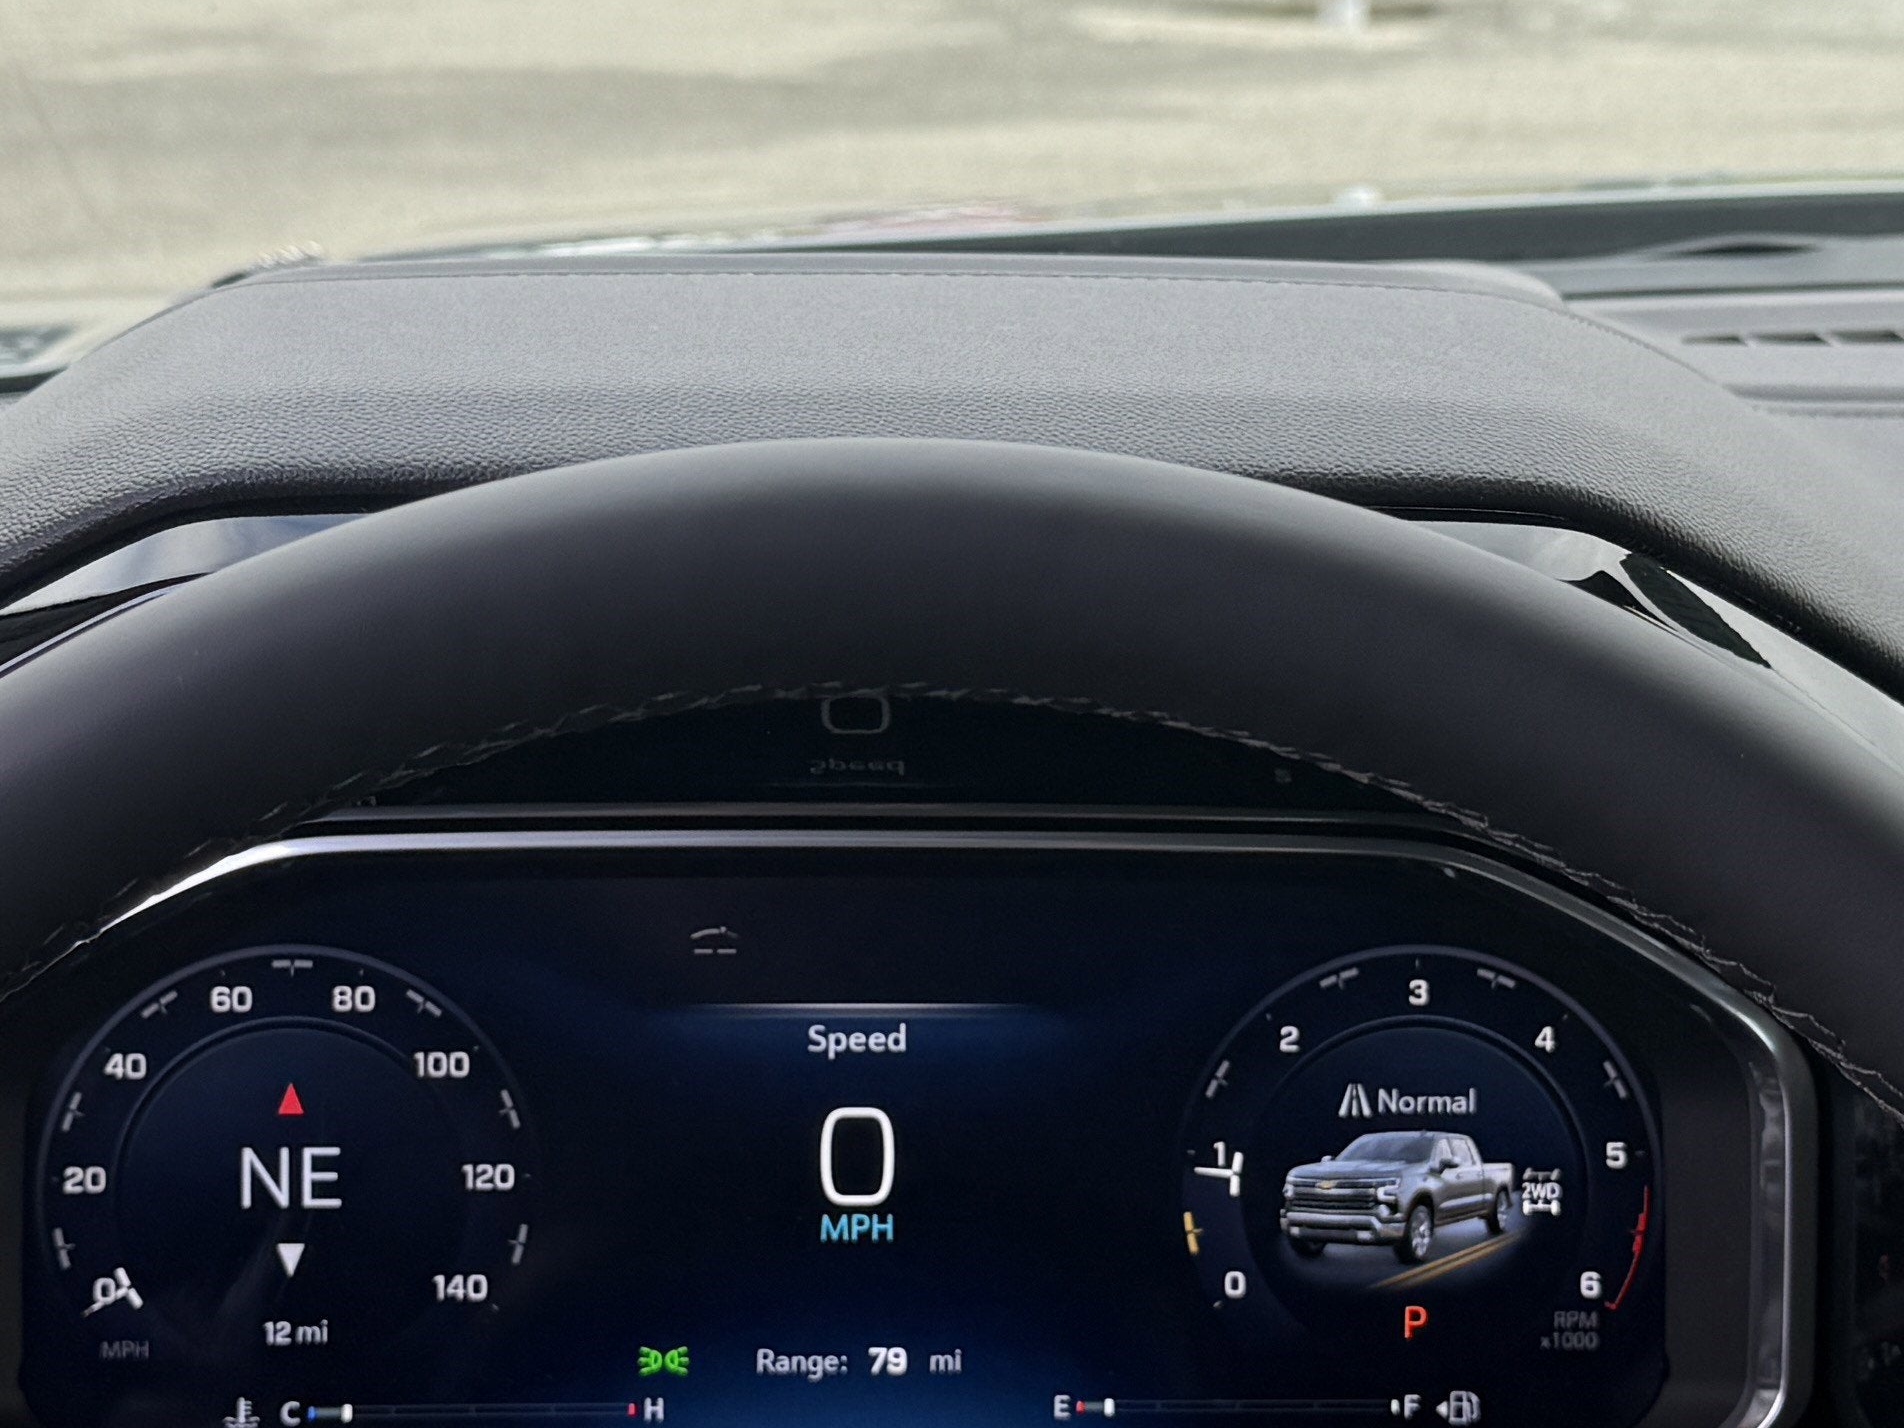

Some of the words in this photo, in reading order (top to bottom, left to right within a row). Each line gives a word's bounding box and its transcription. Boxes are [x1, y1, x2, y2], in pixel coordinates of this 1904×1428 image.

[210, 985, 253, 1013] 60
[331, 985, 376, 1013] 80
[1408, 979, 1430, 1006] 3
[807, 1022, 907, 1061] Speed
[1279, 1025, 1300, 1053] 2
[1534, 1025, 1558, 1052] 4
[104, 1052, 147, 1080] 40
[413, 1051, 470, 1079] 100
[1377, 1088, 1477, 1116] Normal
[819, 1106, 895, 1207] 0
[1212, 1141, 1227, 1167] 1
[1606, 1142, 1628, 1169] 5
[62, 1165, 107, 1194] 20
[240, 1145, 343, 1210] NE
[461, 1163, 515, 1191] 120
[1521, 1182, 1561, 1199] 2WD
[820, 1213, 894, 1243] MPH
[432, 1274, 488, 1302] 140
[1224, 1271, 1247, 1298] 0
[1580, 1271, 1602, 1298] 6
[263, 1319, 292, 1347] 12
[296, 1319, 329, 1345] mi
[1404, 1305, 1428, 1338] P
[1553, 1310, 1598, 1330] RPM
[100, 1340, 150, 1360] MPH
[1540, 1331, 1598, 1350] x1000
[756, 1348, 848, 1383] Range:
[867, 1346, 908, 1376] 79
[929, 1348, 962, 1374] mi
[279, 1400, 302, 1427] C
[644, 1397, 665, 1423] H
[1053, 1394, 1072, 1421] E
[1403, 1394, 1421, 1419] F
